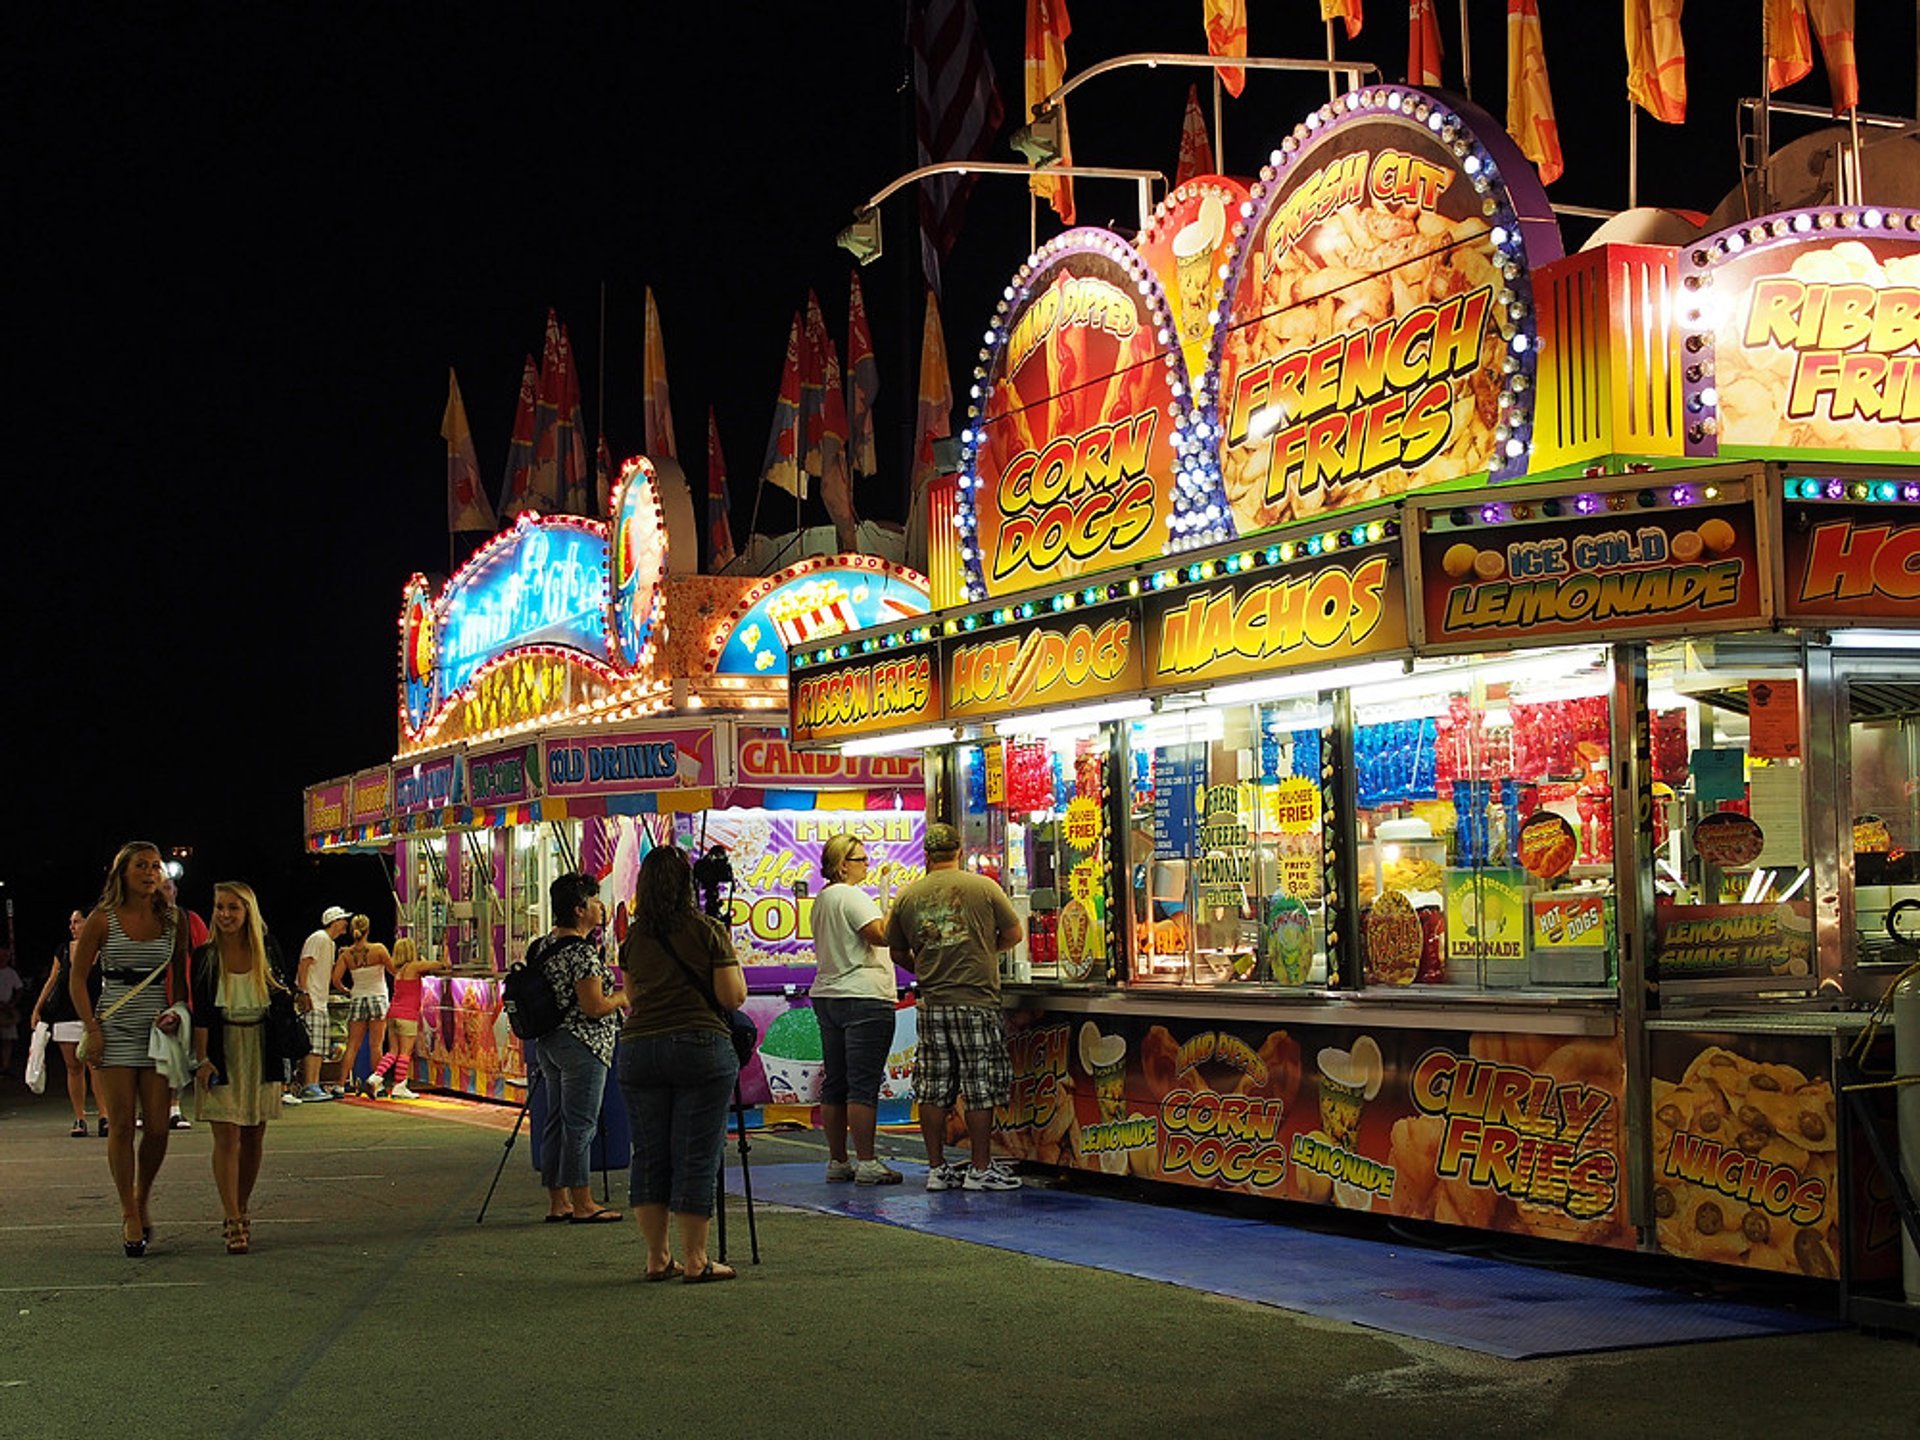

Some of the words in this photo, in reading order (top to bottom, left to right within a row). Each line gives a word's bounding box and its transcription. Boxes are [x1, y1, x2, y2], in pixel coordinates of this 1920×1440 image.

[1264, 150, 1370, 281] FRESH
[1369, 148, 1455, 212] CUT
[1006, 286, 1061, 384] HAND
[1060, 277, 1138, 341] DIPPED
[1227, 286, 1494, 448] FRENCH
[998, 410, 1158, 516] CORN
[1265, 382, 1452, 505] FRIES
[993, 479, 1156, 581] DOGS
[1508, 538, 1567, 578] ICE
[1575, 528, 1668, 568] COLD
[1157, 554, 1388, 675] NACHOS
[1444, 562, 1743, 632] LEMONADE
[797, 666, 871, 731] RIBBON
[871, 653, 931, 718] FRIES
[951, 636, 1019, 709] HOT
[1034, 620, 1132, 693] DOGS
[549, 746, 585, 785] COLD
[587, 740, 678, 782] DRINKS
[795, 815, 912, 842] FRESH
[1207, 784, 1238, 818] FRESH
[1279, 805, 1314, 823] FRIES
[1069, 824, 1096, 838] FRIES
[745, 850, 813, 891] Hot
[1285, 862, 1311, 870] FRITO
[1288, 872, 1308, 880] PIE
[1452, 941, 1521, 957] LEMONADE
[1539, 906, 1562, 934] HOT
[1566, 908, 1599, 941] DOGS
[1664, 915, 1778, 945] LEMONADE
[1658, 947, 1739, 970] SHAKE
[1744, 945, 1791, 969] UPS
[1006, 1024, 1071, 1080] NCH
[990, 1073, 1057, 1131] IES
[1160, 1090, 1285, 1143] CORN
[1411, 1047, 1614, 1143] CURLY
[1080, 1115, 1157, 1154] LEMONADE
[1162, 1131, 1286, 1189] DOGS
[1291, 1133, 1395, 1200] LEMONADE
[1436, 1114, 1619, 1221] FRIES
[1665, 1129, 1830, 1226] NACHOS
